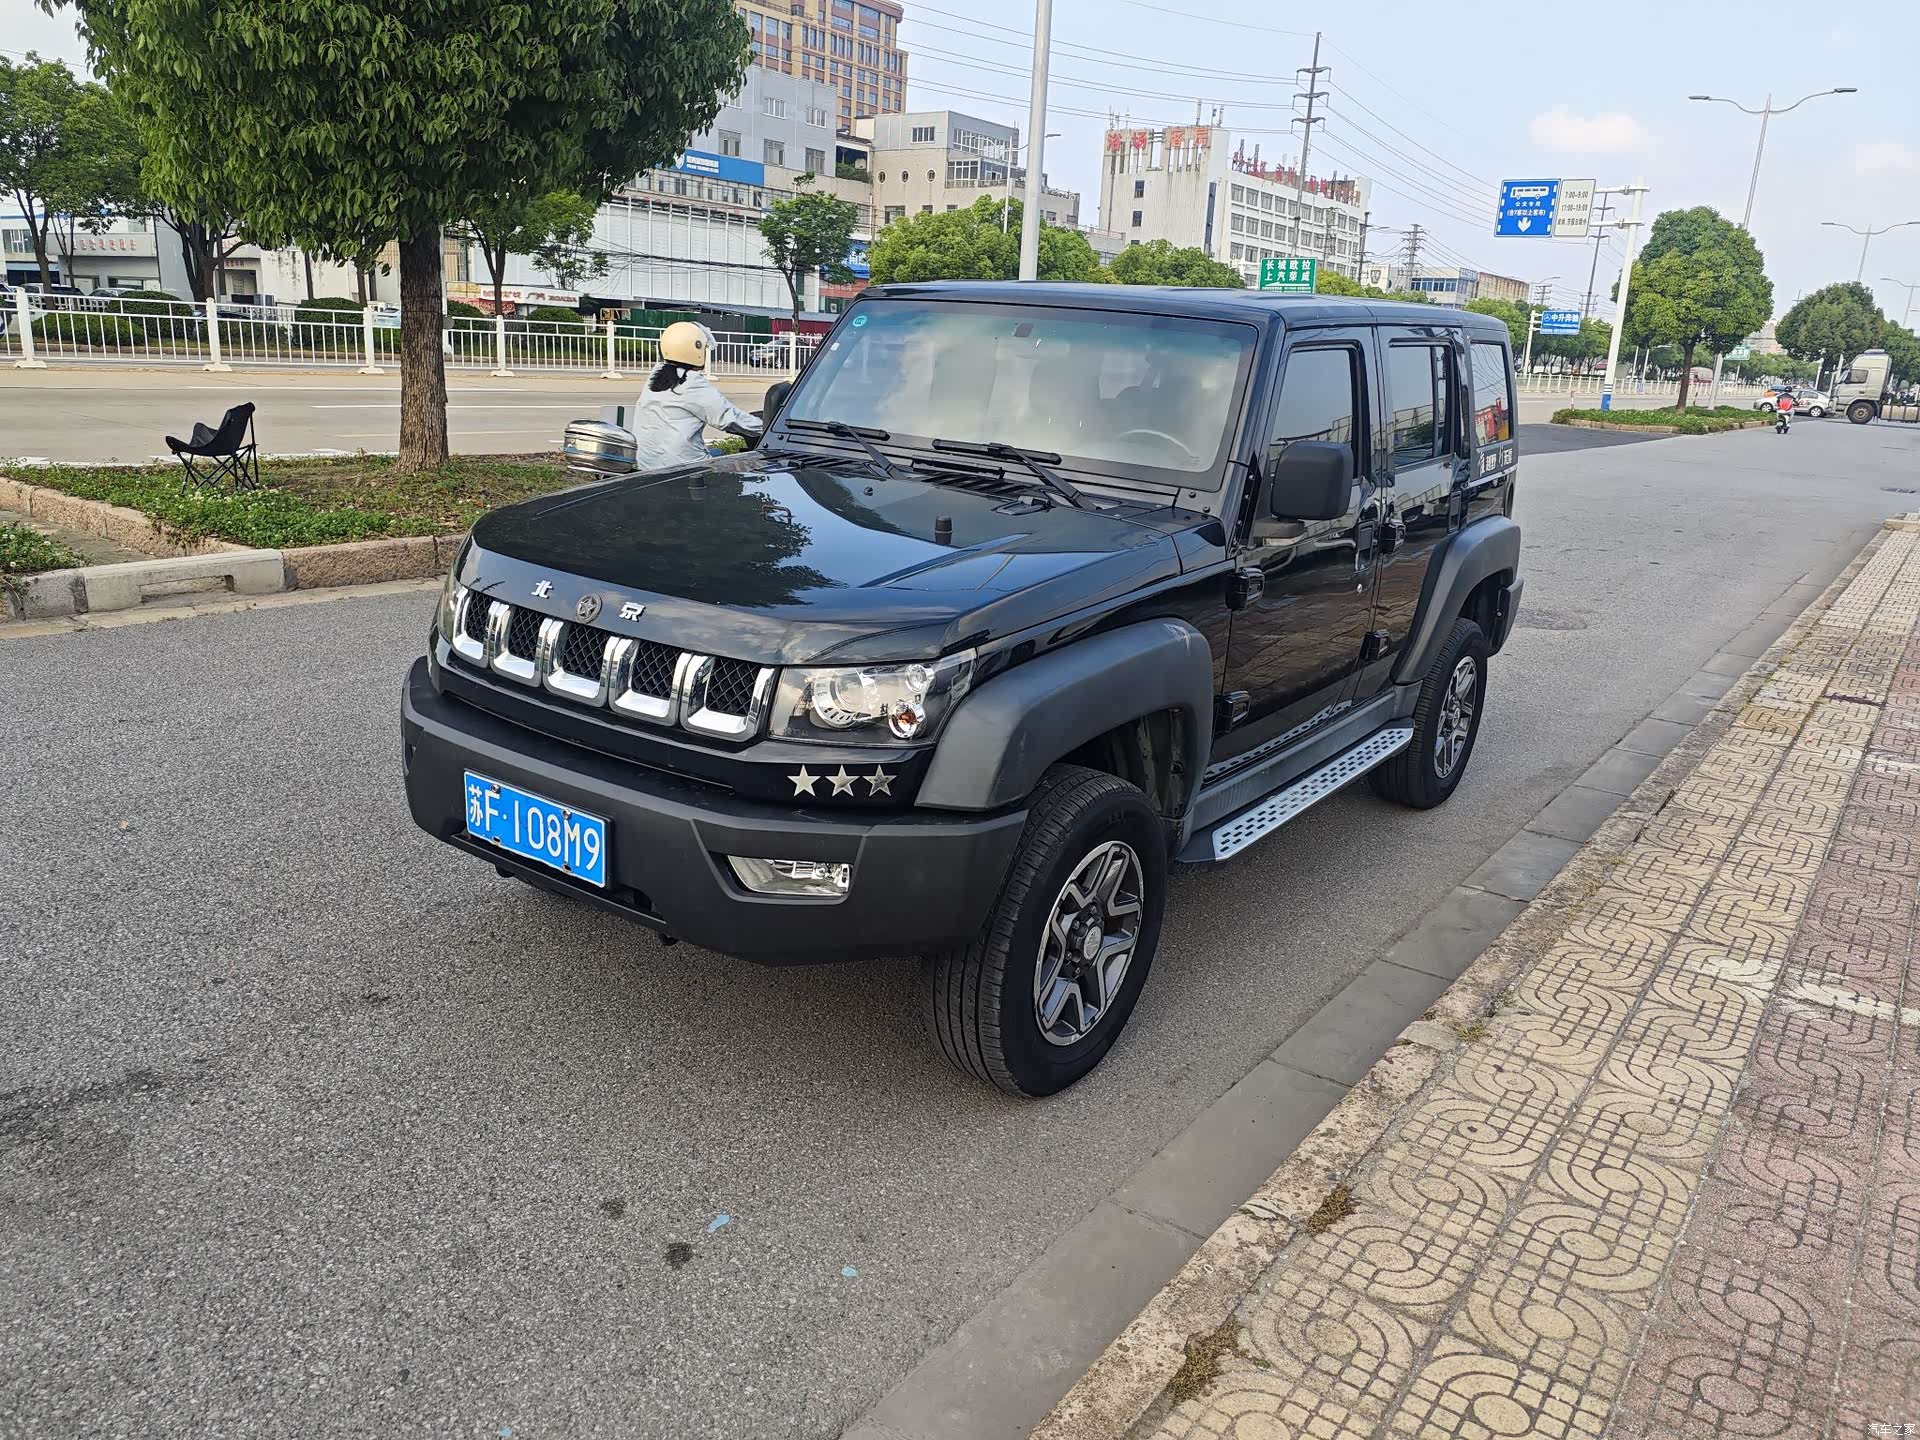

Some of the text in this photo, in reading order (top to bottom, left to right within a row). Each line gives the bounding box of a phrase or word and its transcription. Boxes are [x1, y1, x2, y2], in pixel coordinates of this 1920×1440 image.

[1266, 260, 1311, 270] 长城欧拉
[1264, 271, 1310, 281] 上汽荣威
